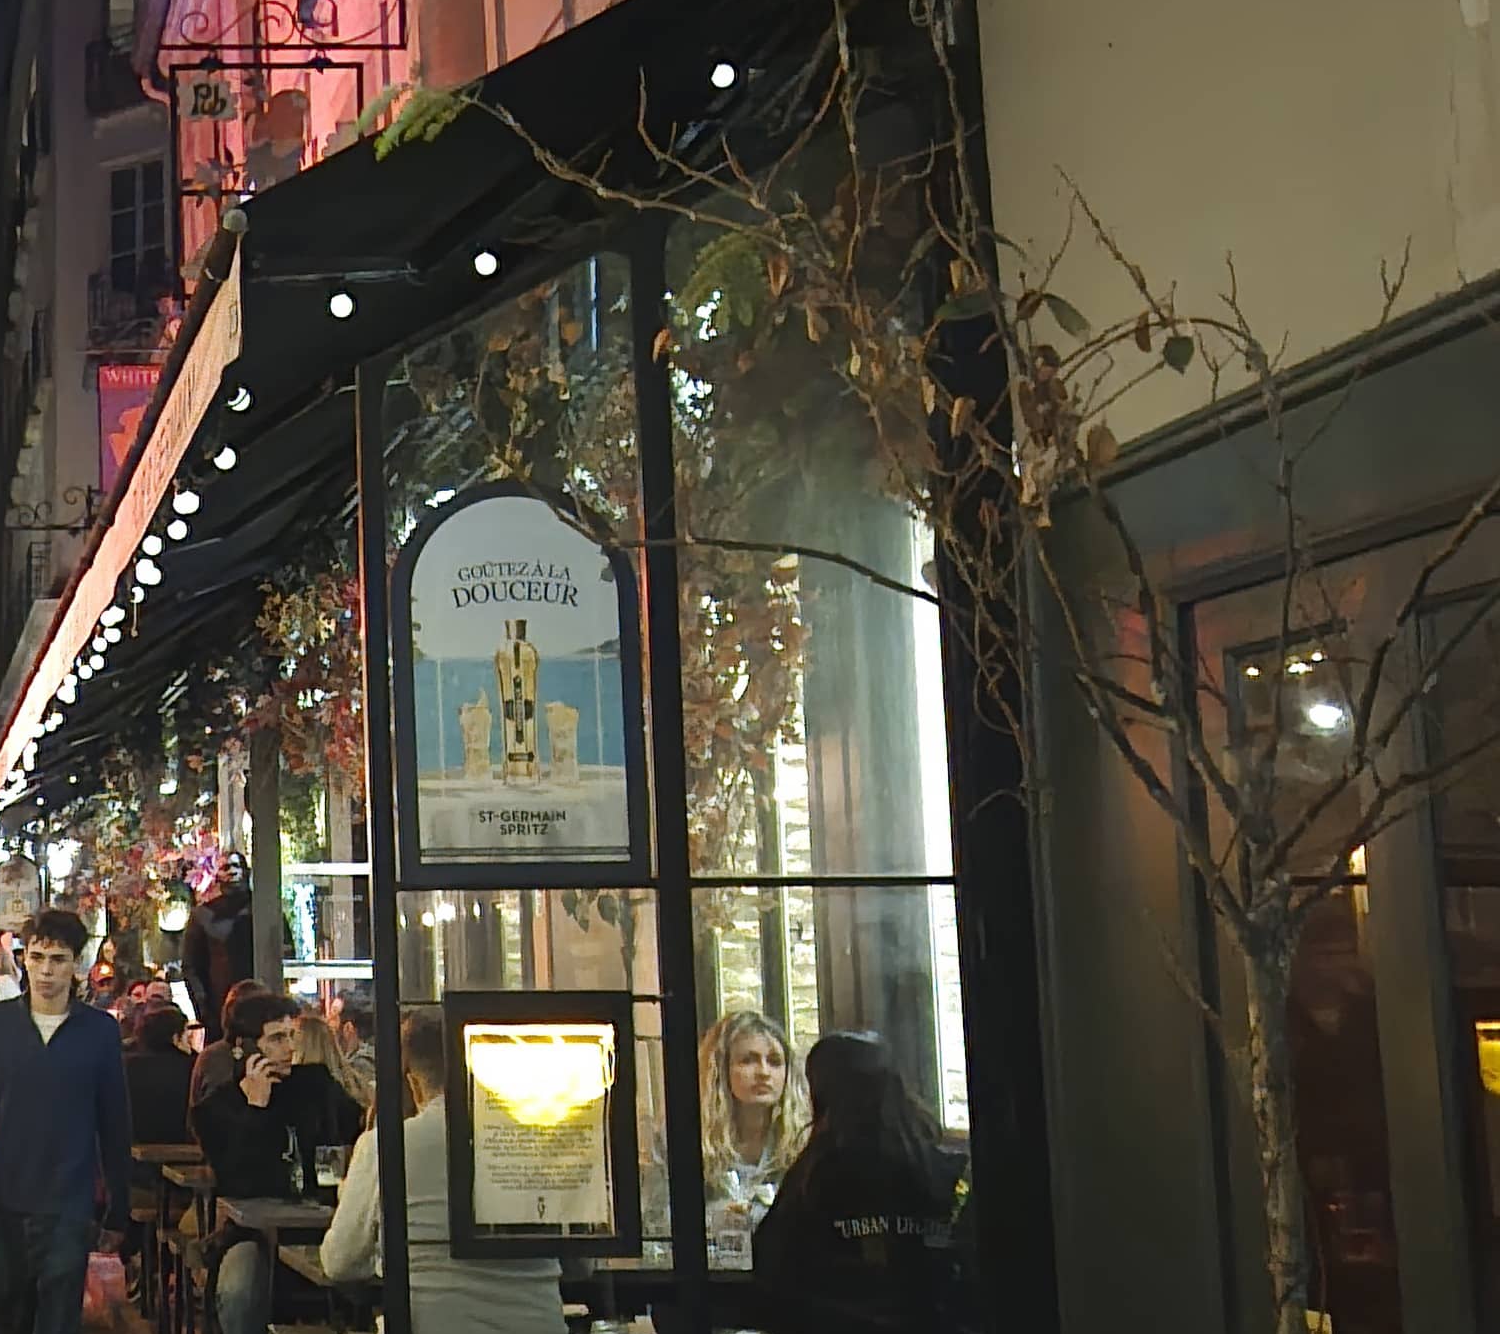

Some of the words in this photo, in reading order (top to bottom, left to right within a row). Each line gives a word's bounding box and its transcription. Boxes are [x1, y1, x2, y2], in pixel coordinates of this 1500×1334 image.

[457, 561, 529, 583] GOÛTEZ
[548, 564, 571, 581] LA
[451, 580, 578, 608] DOUCEUR
[478, 810, 566, 823] ST-GERMAIN
[499, 823, 549, 836] SPRITZ
